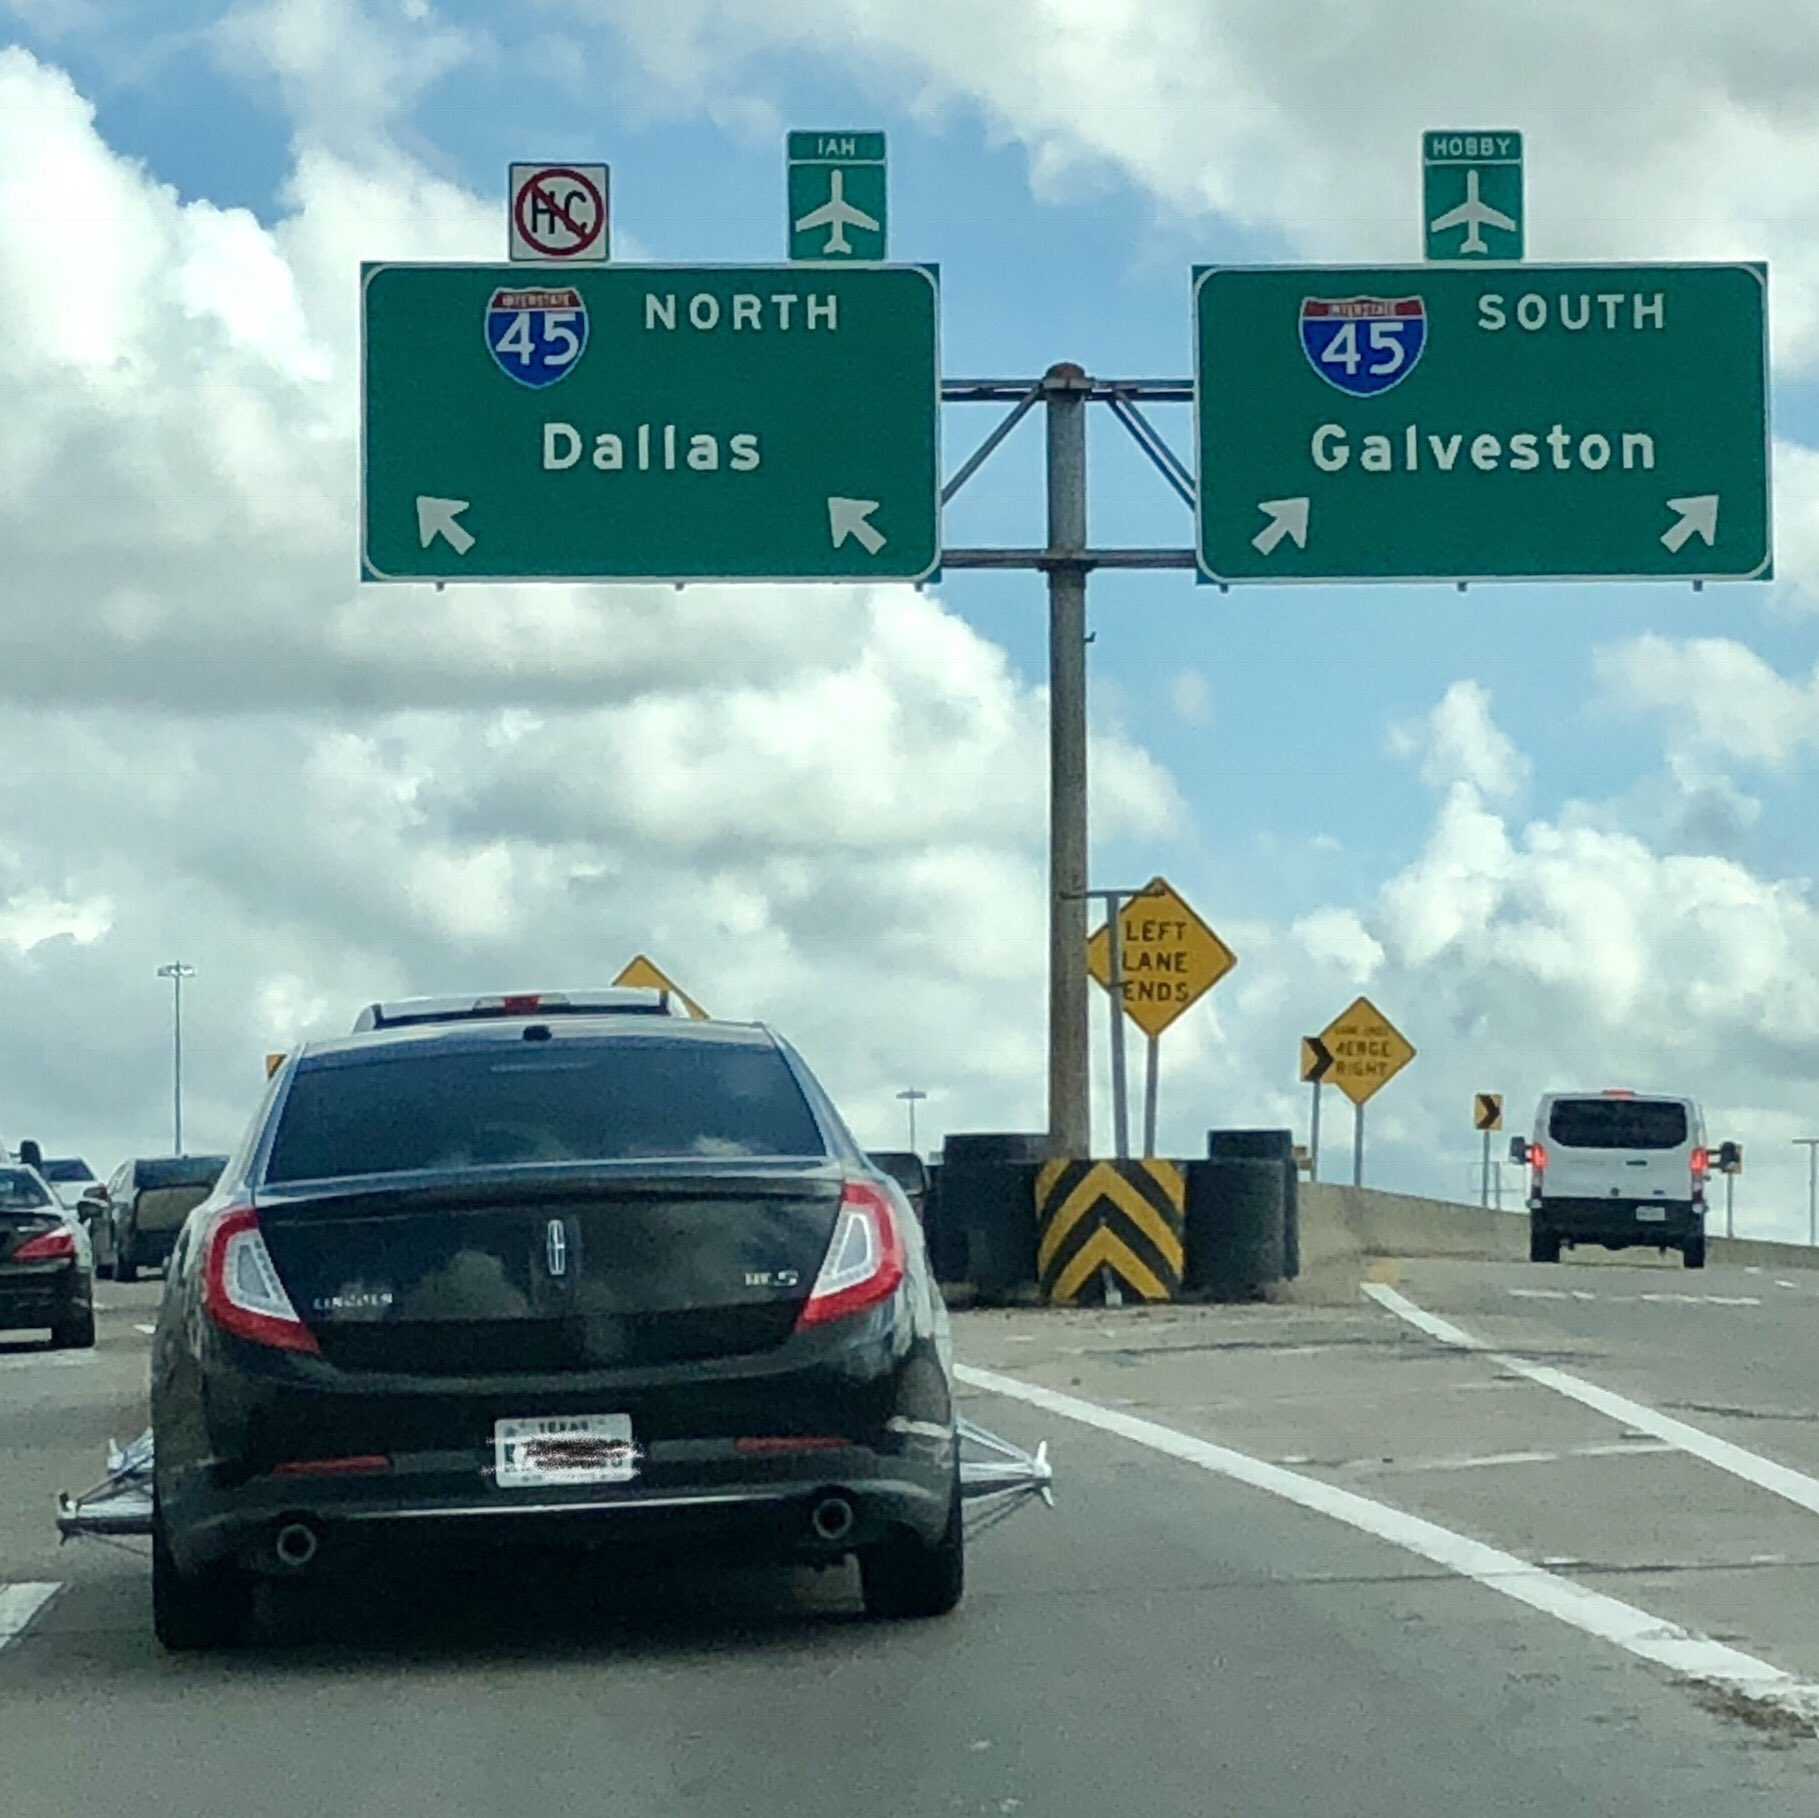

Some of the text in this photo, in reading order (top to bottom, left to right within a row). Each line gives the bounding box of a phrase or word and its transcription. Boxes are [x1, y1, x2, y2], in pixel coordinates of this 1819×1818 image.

[817, 137, 856, 156] IAH
[1432, 136, 1511, 156] HOBBY
[530, 190, 588, 234] HC
[645, 293, 838, 330] NORTH
[1478, 293, 1665, 330] SOUTH
[495, 311, 579, 366] 45
[1321, 321, 1405, 375] 45
[543, 422, 760, 471] Dallas
[1311, 423, 1655, 471] Galveston
[1126, 920, 1187, 941] LEFT
[1122, 951, 1188, 973] LANE
[1123, 980, 1189, 1002] ENDS
[1336, 1060, 1388, 1077] RIGHT
